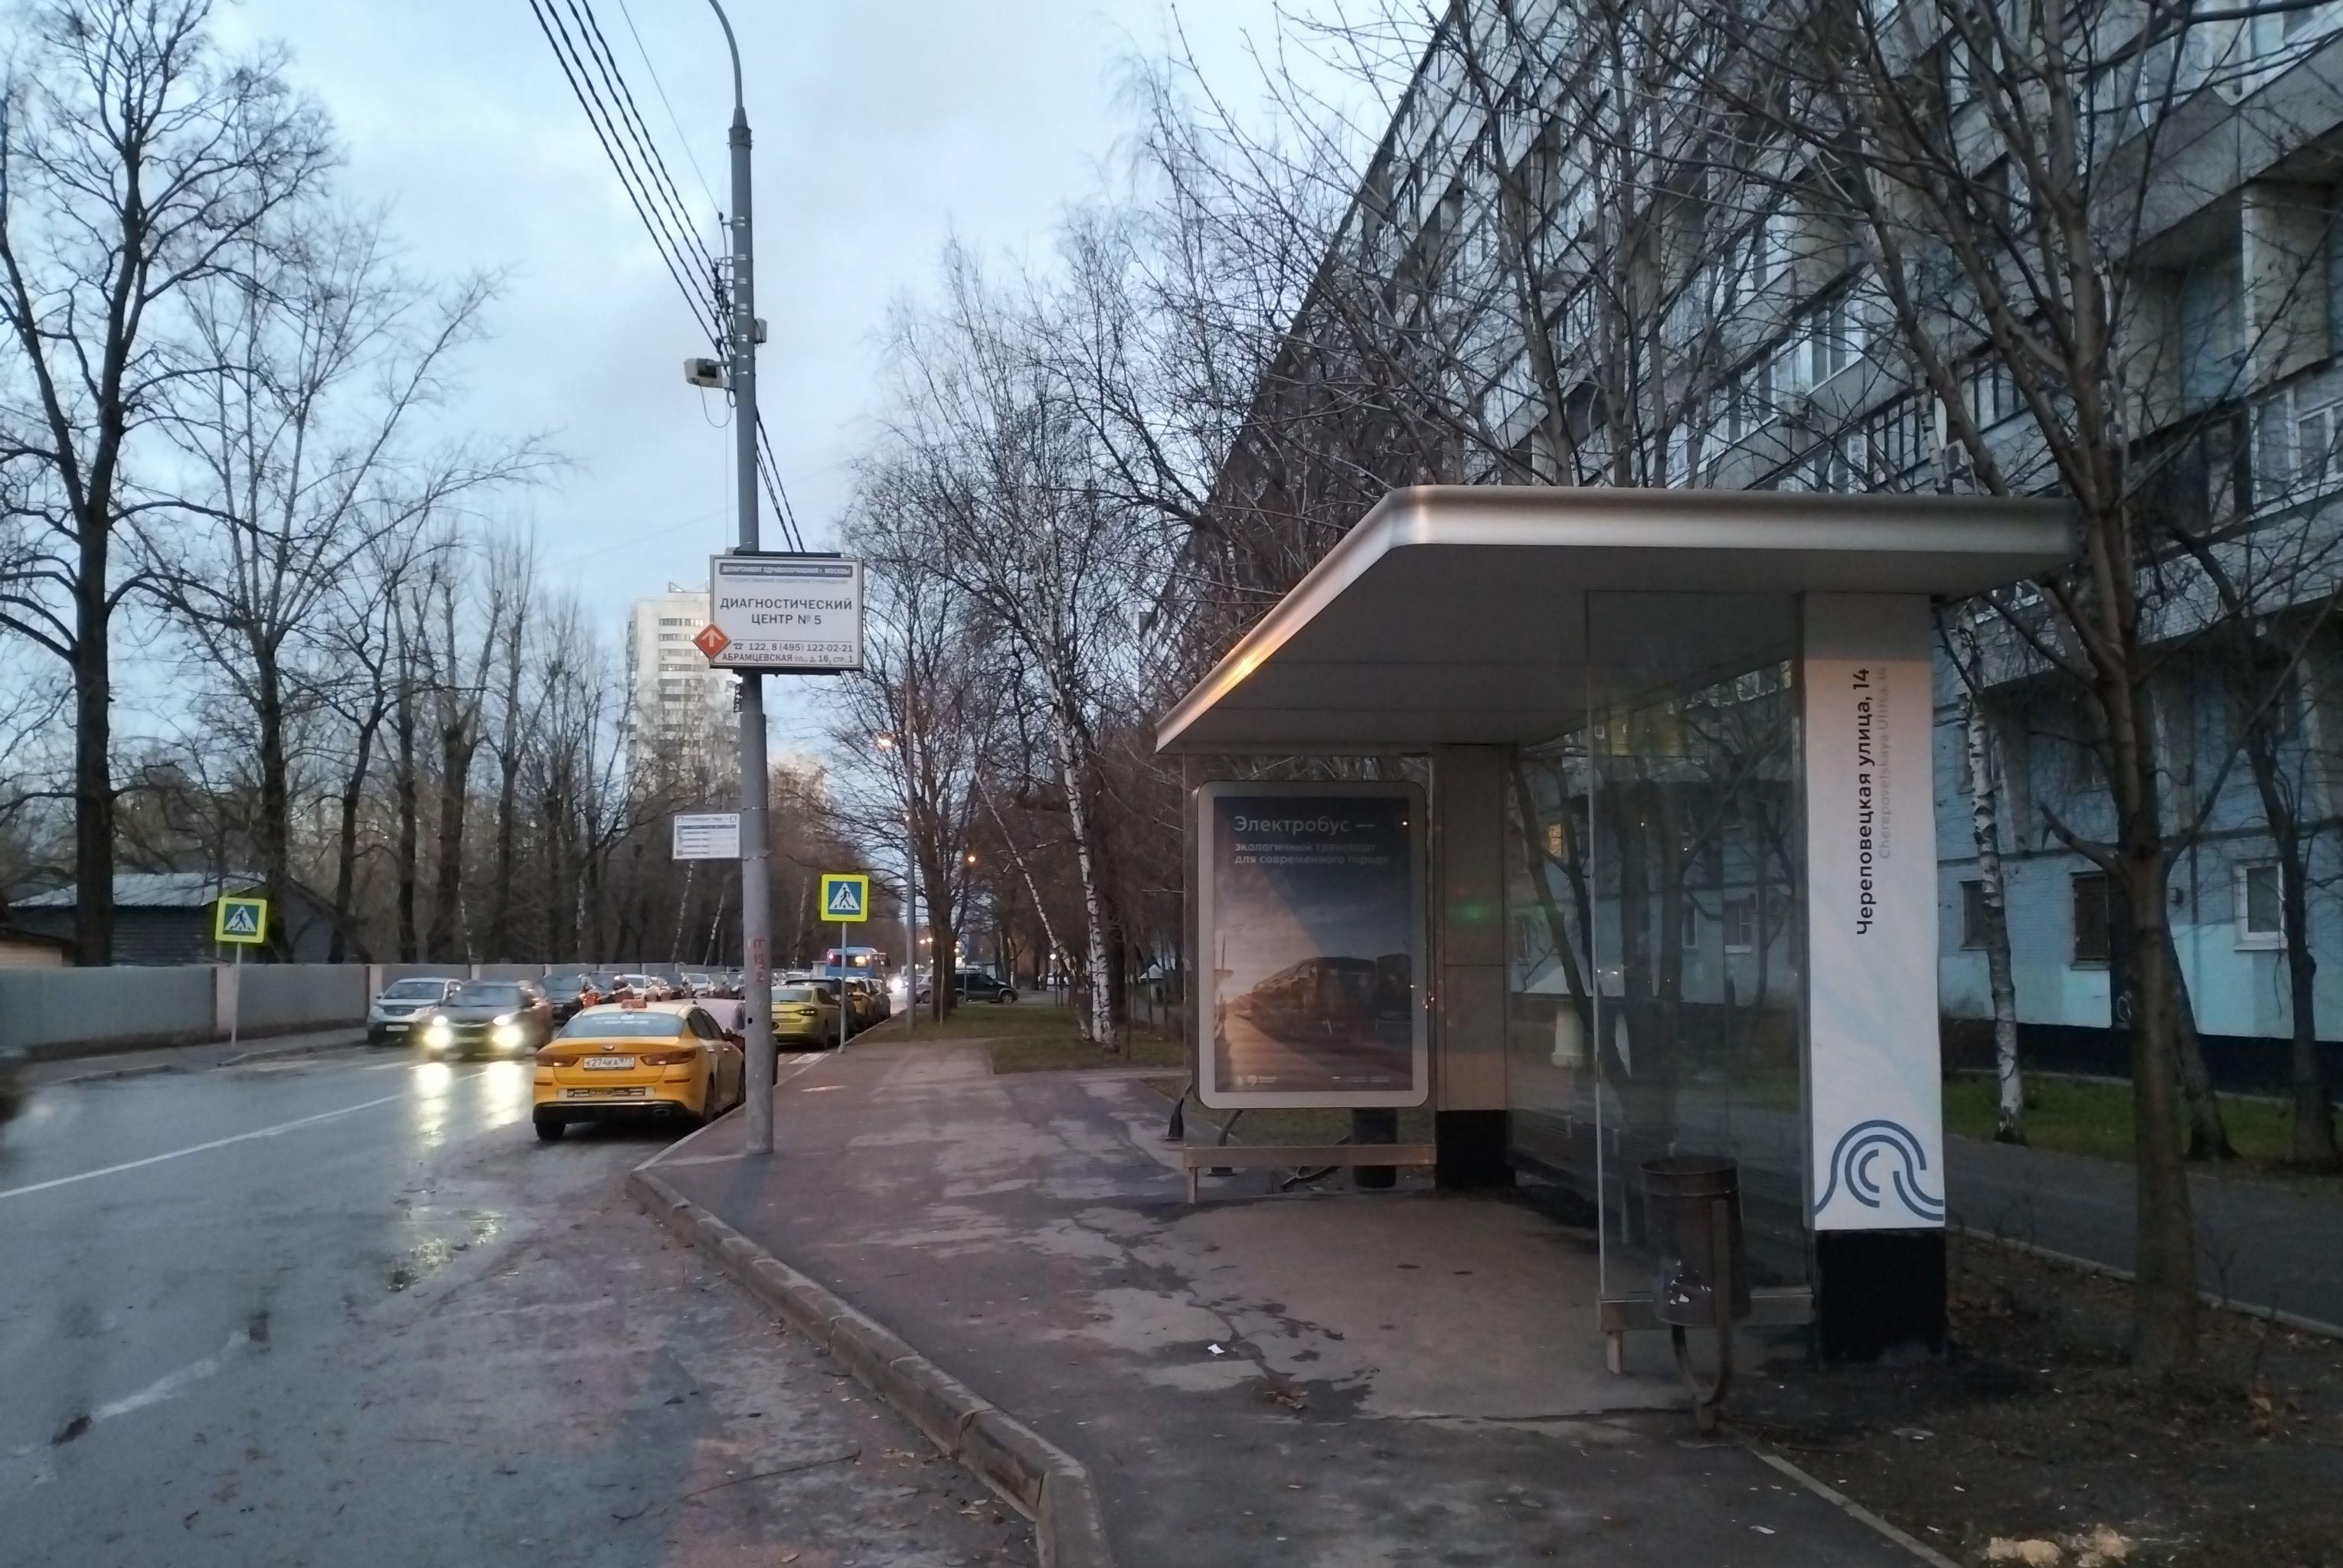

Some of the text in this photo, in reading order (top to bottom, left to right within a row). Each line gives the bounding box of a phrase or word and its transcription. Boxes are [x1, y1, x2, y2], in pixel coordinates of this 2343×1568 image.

[720, 598, 852, 610] ДИАГНОСТИЧЕСКИЙ
[751, 613, 793, 626] ЦЕНТР
[814, 616, 822, 626] 5
[771, 643, 777, 652] 8
[779, 643, 804, 652] (495)
[806, 644, 853, 652] 122-02-21
[722, 653, 792, 662] АБРАМЦЕВСКАЯ
[1853, 668, 1876, 935] Череповецкая улица, 14
[1234, 815, 1350, 835] Электробус
[1234, 855, 1256, 864] для
